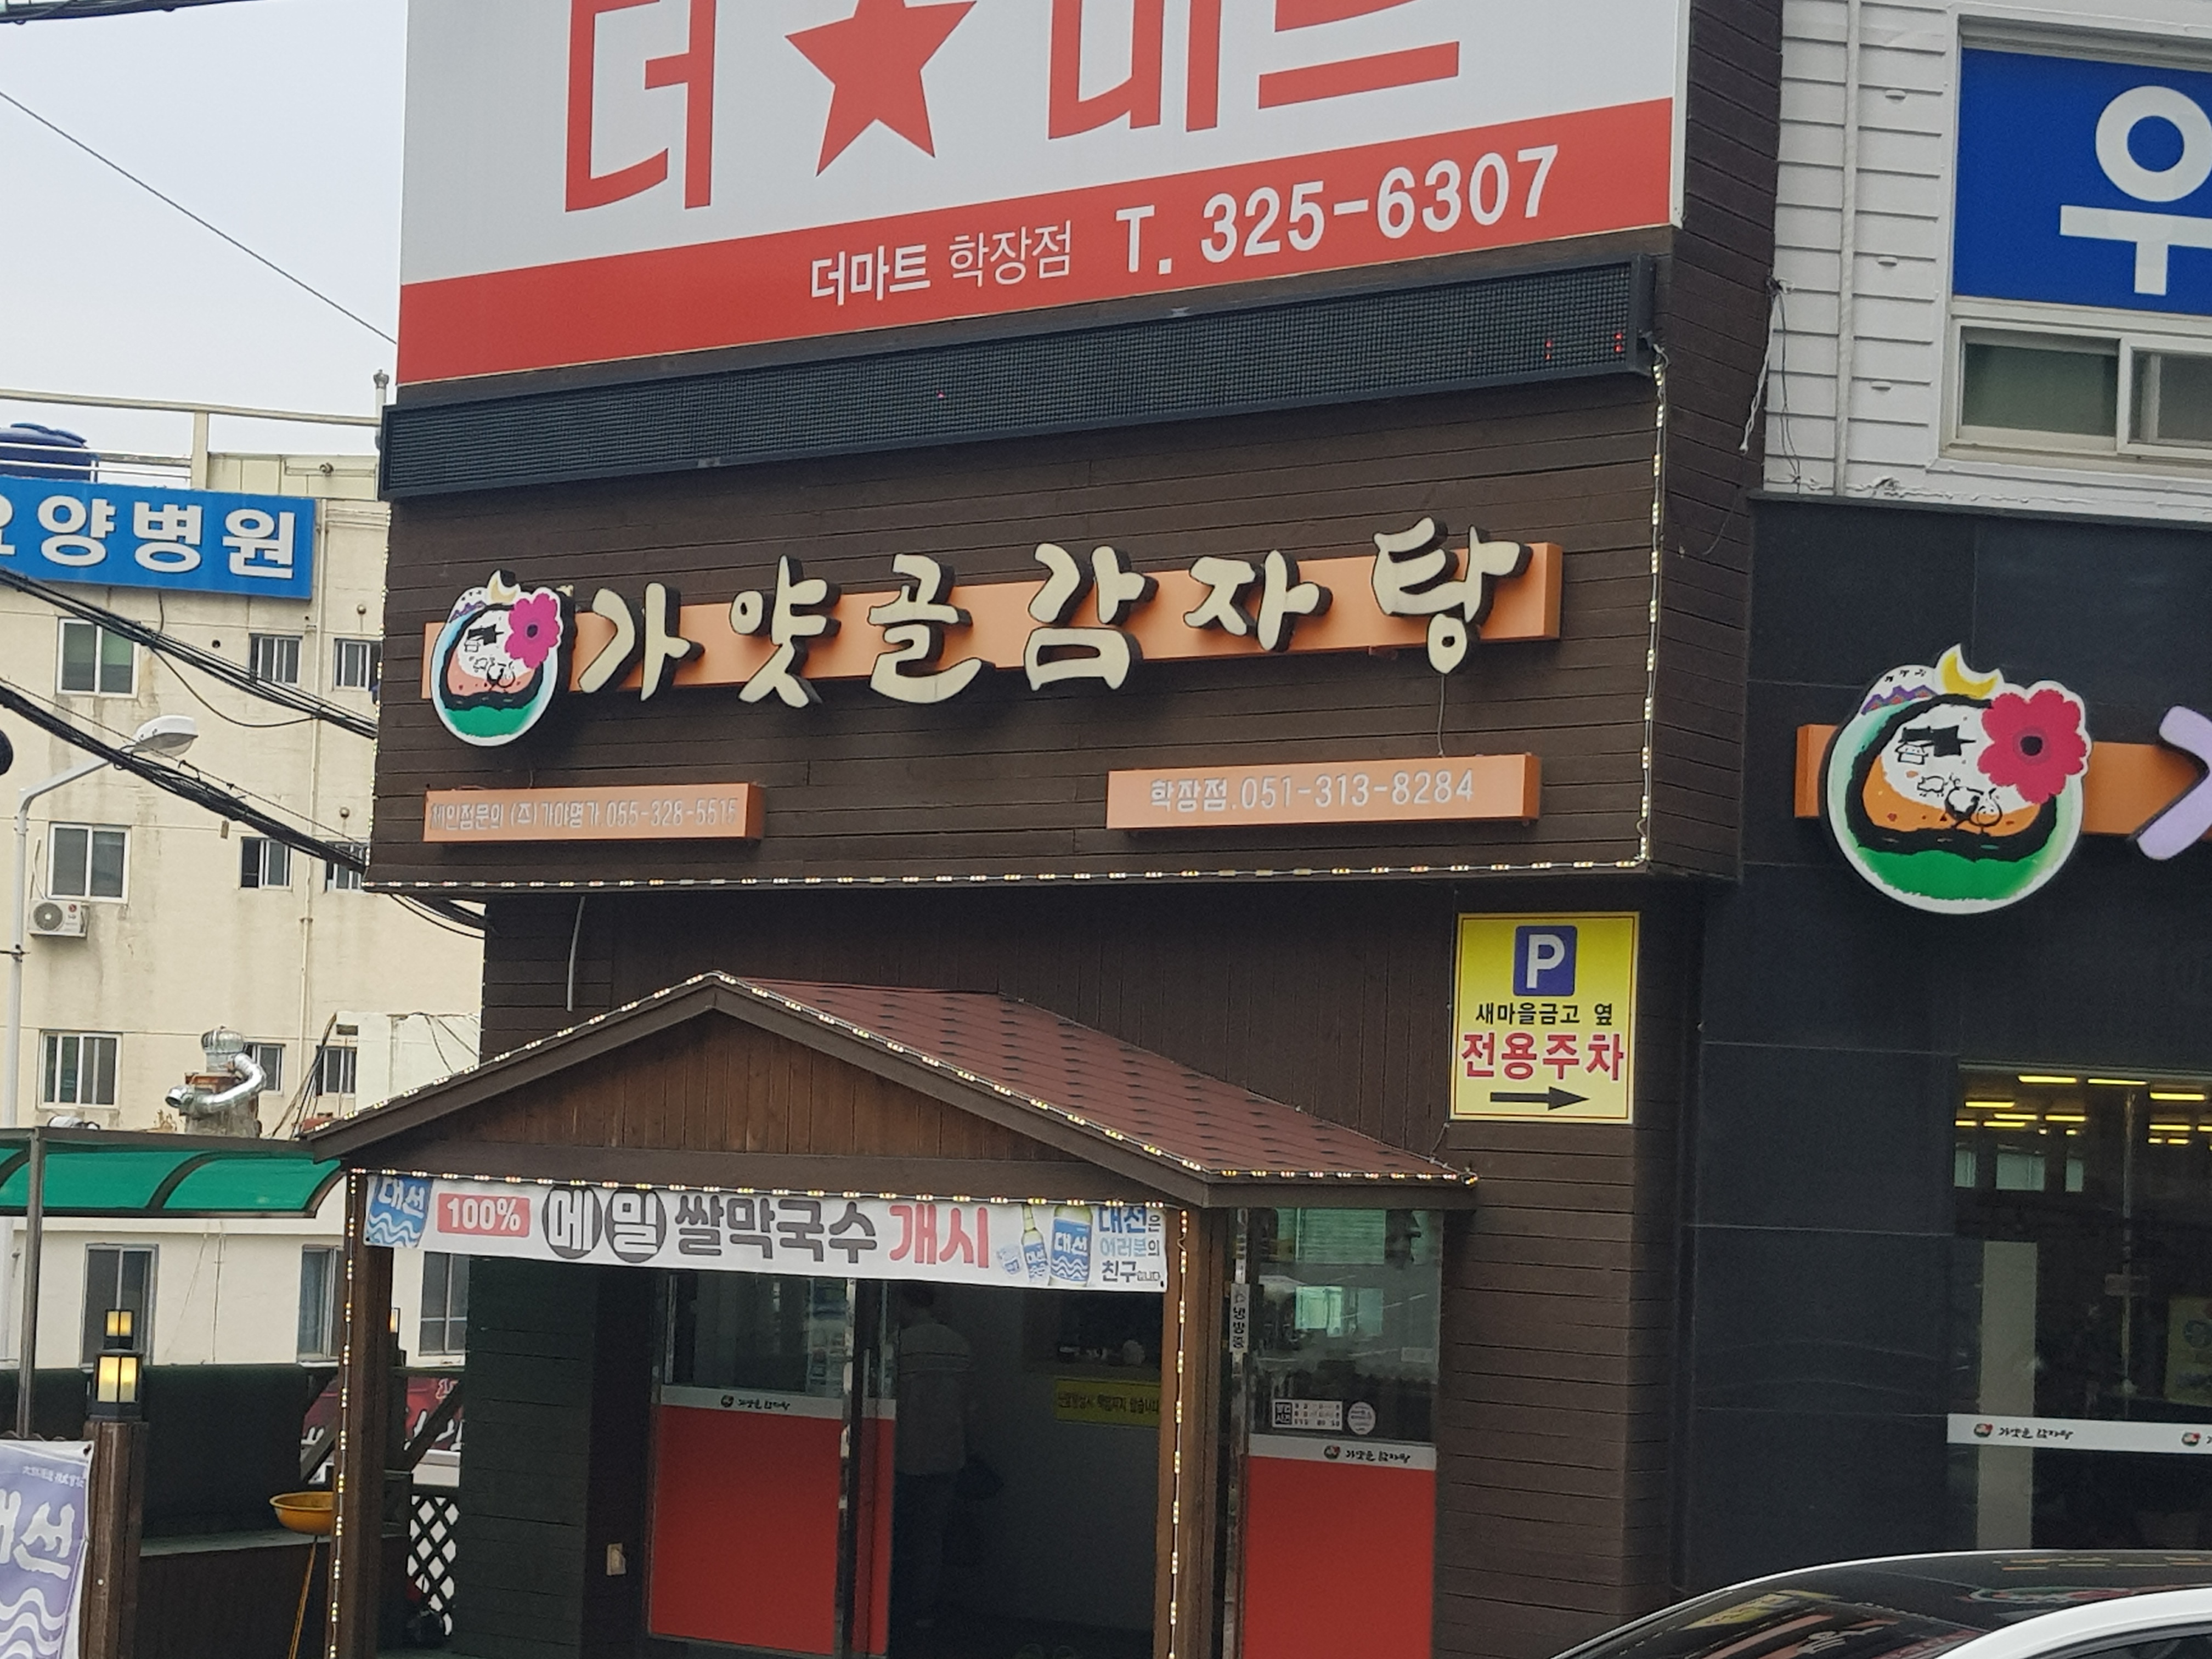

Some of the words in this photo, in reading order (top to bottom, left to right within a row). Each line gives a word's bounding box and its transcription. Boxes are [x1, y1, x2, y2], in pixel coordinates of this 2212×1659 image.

[810, 241, 930, 307] 더마트
[949, 219, 1073, 289] 학장점
[1115, 204, 1172, 275] T.
[1200, 144, 1559, 263] 325-6307
[0, 494, 296, 580] 양병원
[1526, 934, 1565, 989] P
[1475, 1002, 1581, 1025] 새마을금고
[1594, 1002, 1613, 1026] 옆
[1461, 1032, 1624, 1081] 전용주차
[447, 1197, 522, 1233] 100%
[889, 1202, 990, 1269] 개시
